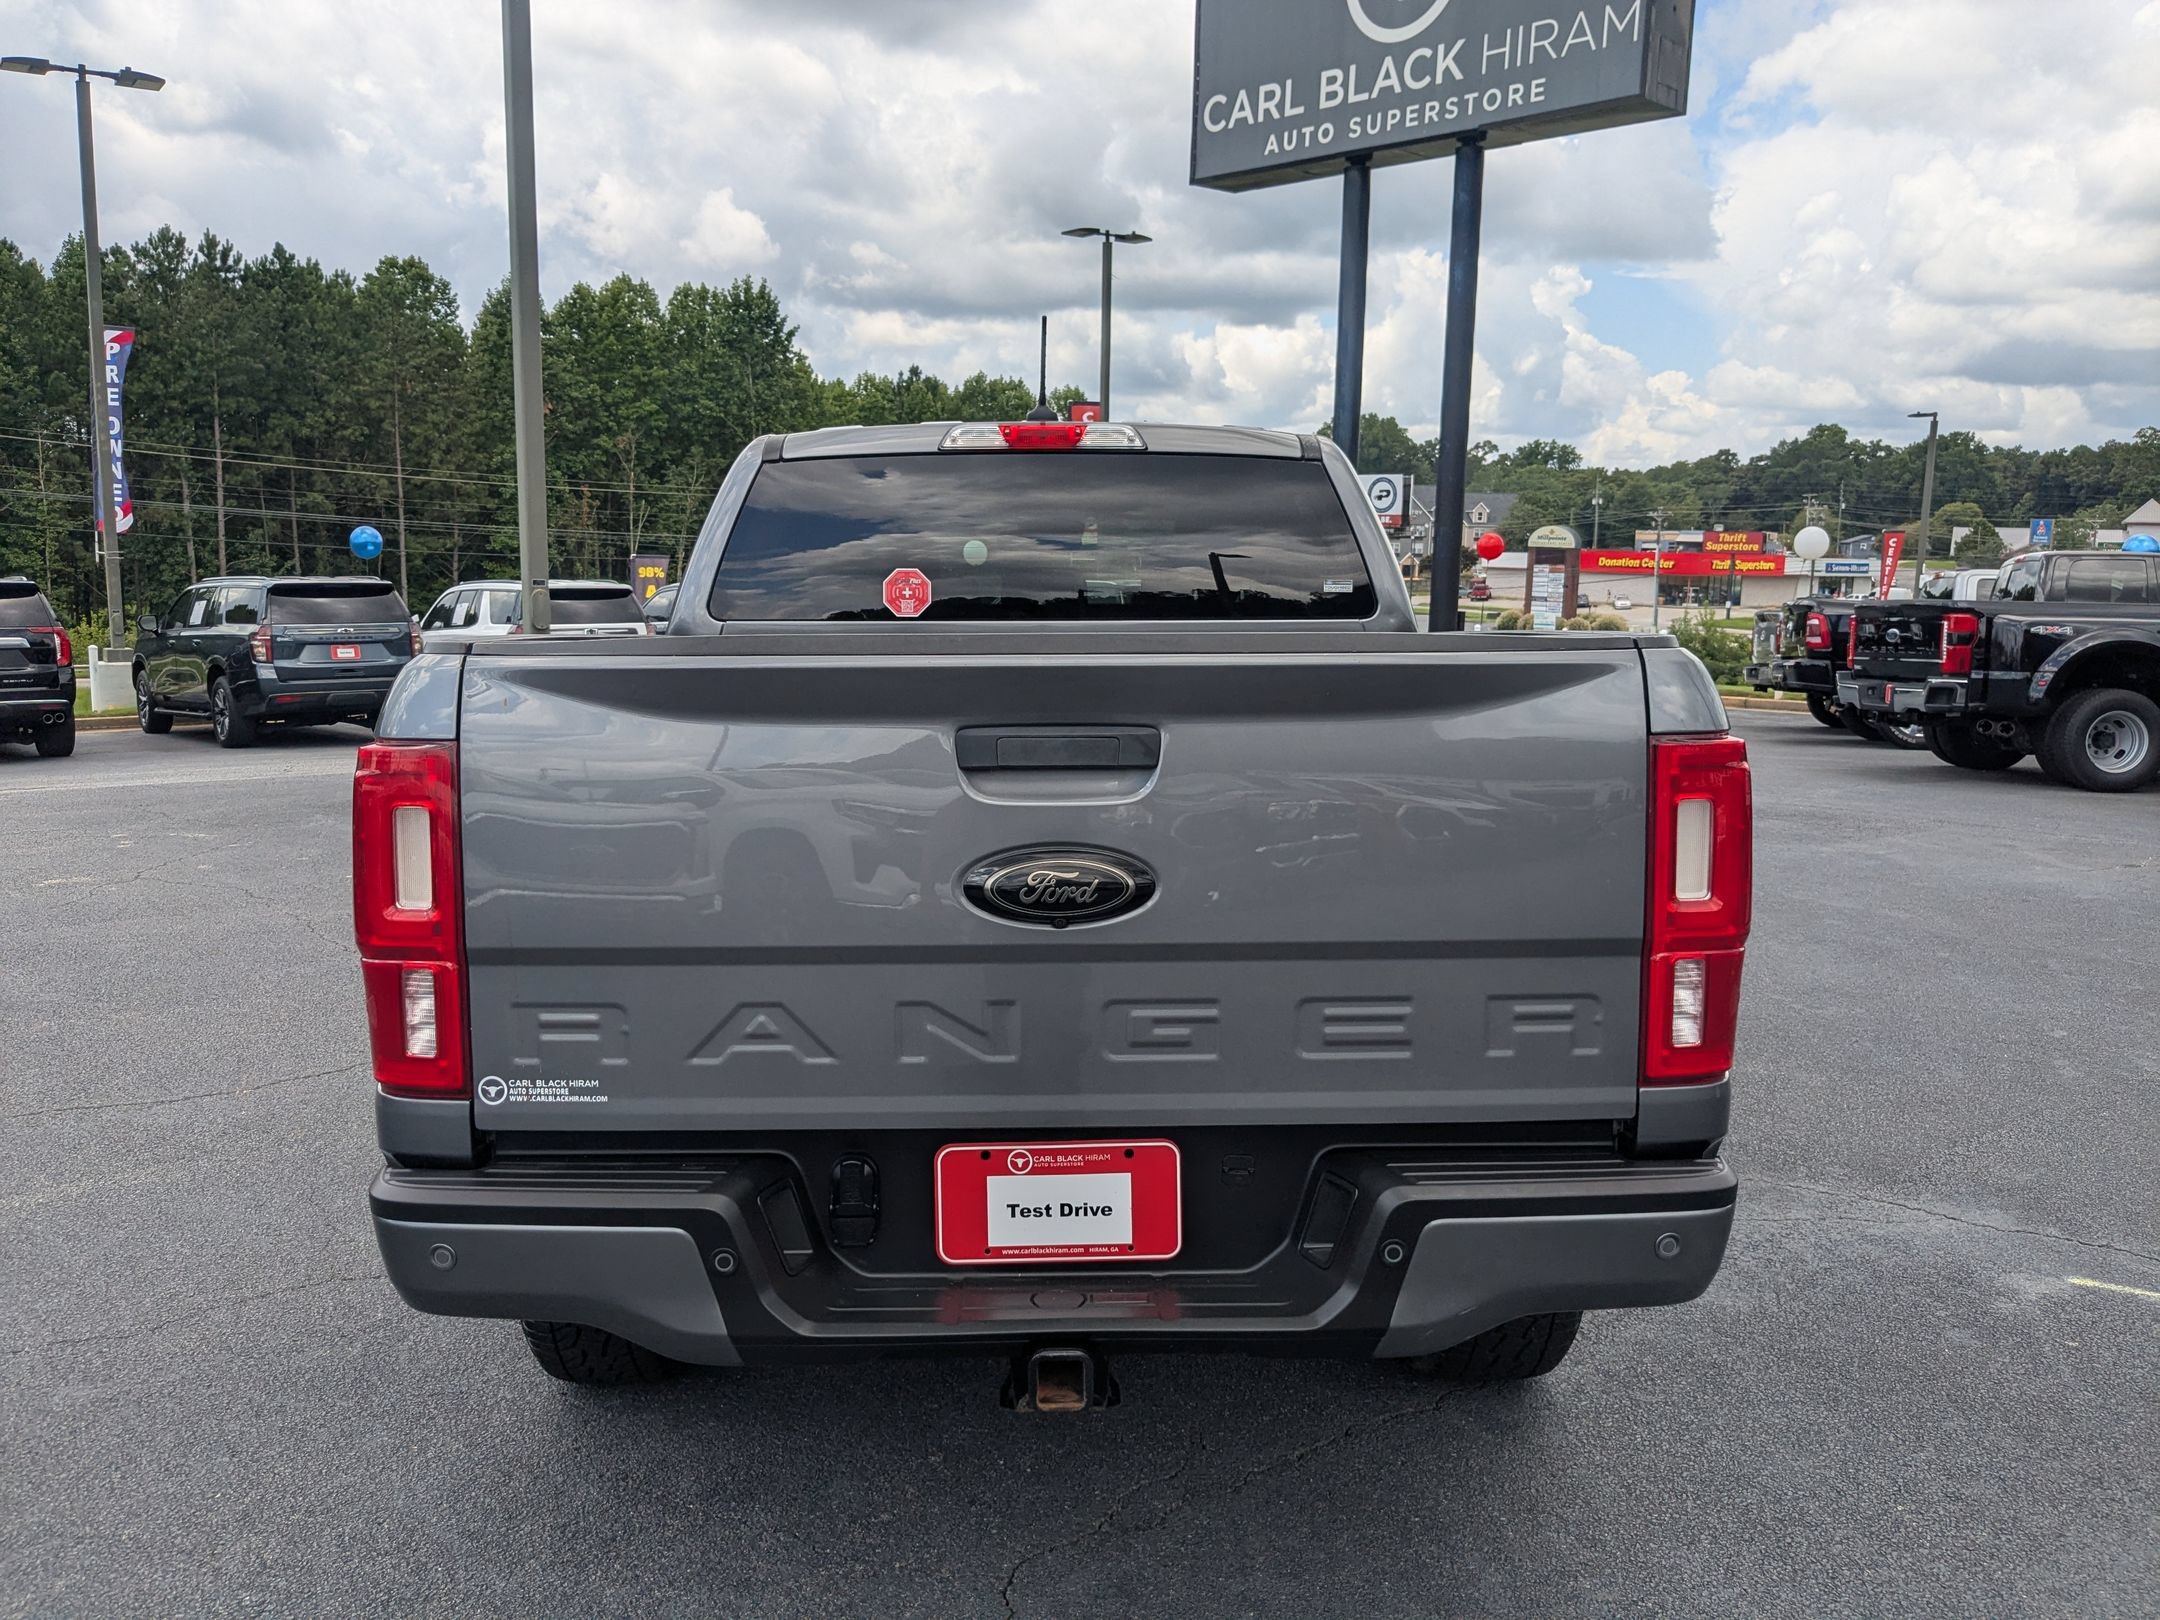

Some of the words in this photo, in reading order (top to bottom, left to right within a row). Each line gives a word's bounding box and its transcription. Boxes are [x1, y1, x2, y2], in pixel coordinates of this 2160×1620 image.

[1203, 78, 1305, 133] CARL
[1319, 38, 1464, 111] BLACK
[1481, 0, 1640, 76] HIRAM
[1263, 123, 1335, 156] AUTO
[1348, 78, 1547, 139] SUPERSTORE
[105, 342, 121, 406] PRE
[1719, 533, 1747, 543] Thrift
[1705, 542, 1759, 553] Superstore
[1598, 556, 1640, 568] Donation
[1641, 557, 1675, 569] Ceter
[1711, 560, 1731, 569] Thrif
[1735, 560, 1776, 571] Superstore
[638, 566, 665, 578] 98%
[1018, 868, 1099, 904] Ford
[509, 992, 1605, 1065] RANGER
[508, 1079, 534, 1088] CARL
[536, 1079, 567, 1088] BLACK
[569, 1079, 599, 1088] HIRAM
[1033, 1155, 1056, 1163] CARL
[1057, 1154, 1084, 1162] BLACK
[1085, 1153, 1111, 1161] HIRAM
[1006, 1203, 1053, 1218] Test
[1059, 1201, 1113, 1218] Drive
[1001, 1247, 1085, 1255] www.carlblackhiram.com
